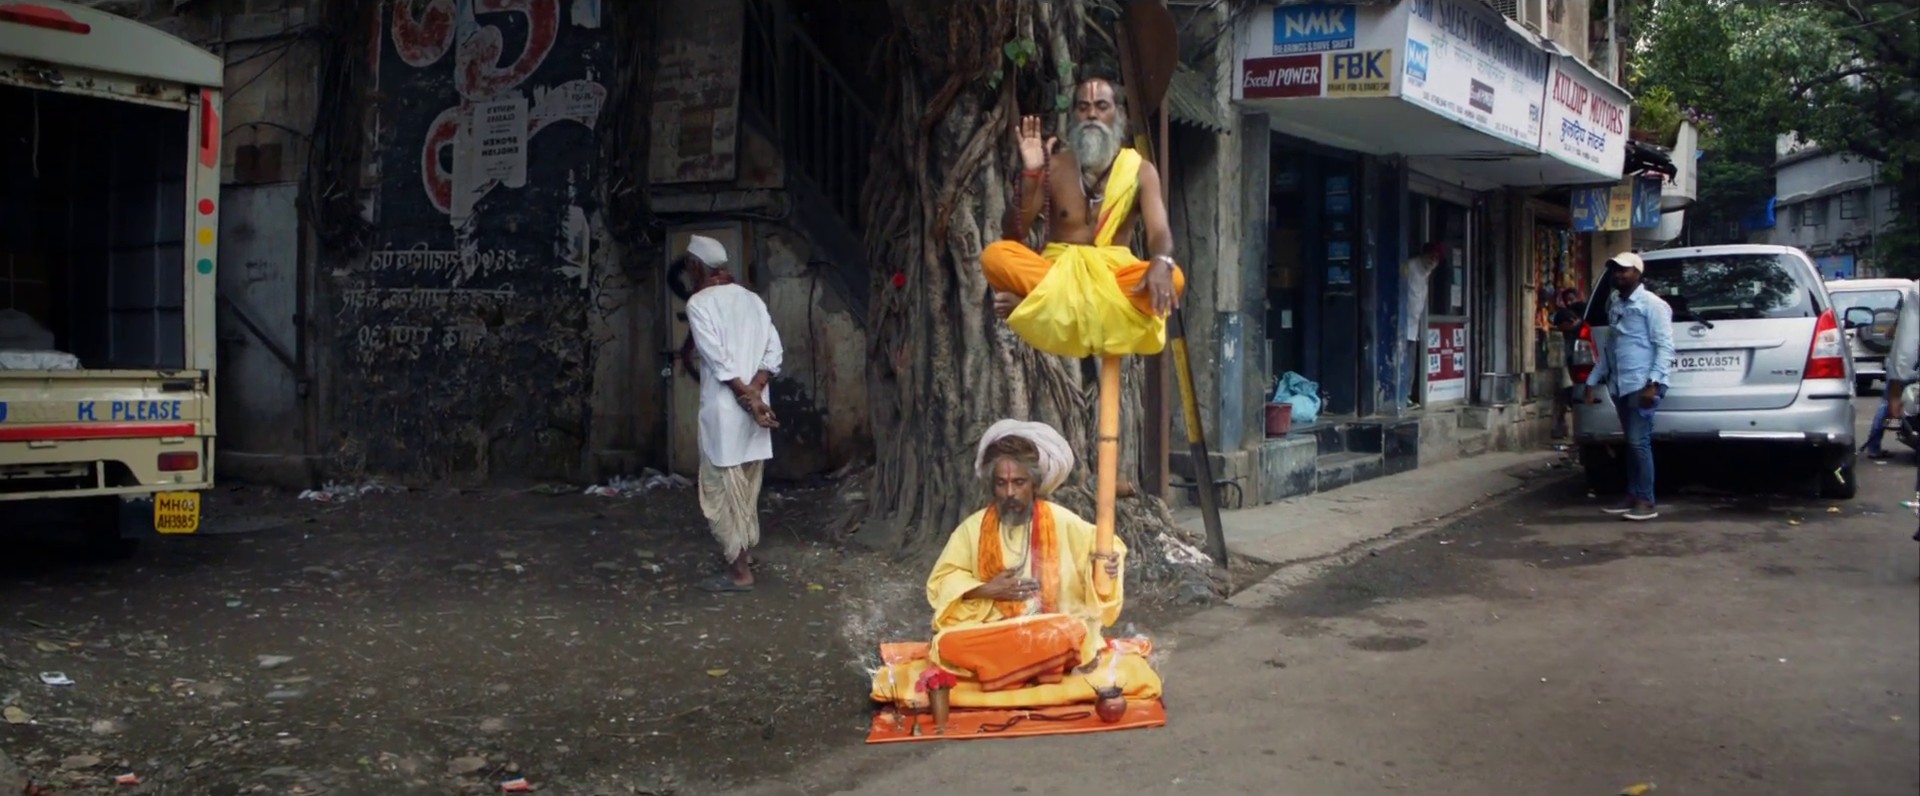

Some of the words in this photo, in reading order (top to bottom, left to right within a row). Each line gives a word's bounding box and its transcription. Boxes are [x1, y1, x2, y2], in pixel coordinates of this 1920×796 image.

[1285, 9, 1346, 38] NMK
[1332, 38, 1353, 49] SHAFT
[1333, 50, 1384, 80] FBK
[1243, 69, 1277, 88] Excell
[1276, 66, 1320, 86] POWER
[1553, 69, 1588, 115] KULDIP
[1589, 92, 1625, 135] MOTORS
[1681, 355, 1741, 368] 02.CV.8571
[77, 401, 98, 422] K
[111, 400, 183, 421] PLEASE
